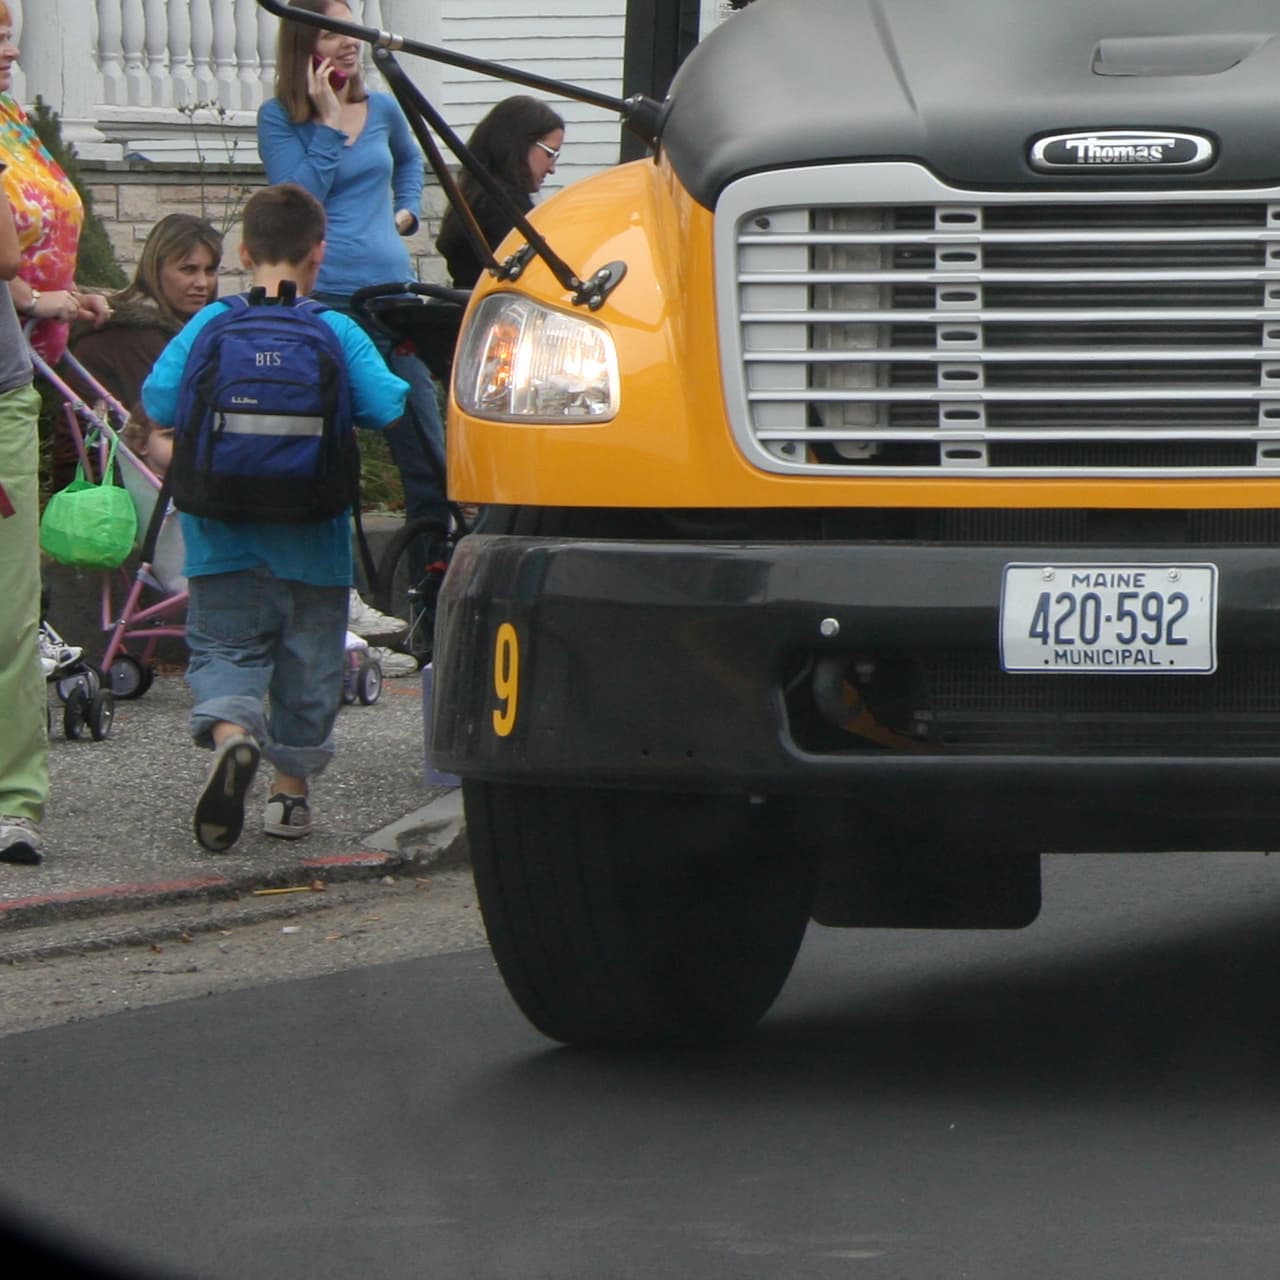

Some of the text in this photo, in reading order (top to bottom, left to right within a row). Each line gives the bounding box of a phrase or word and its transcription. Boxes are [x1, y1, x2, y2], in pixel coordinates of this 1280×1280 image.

[1066, 138, 1175, 164] Thomas
[256, 352, 281, 366] BTS
[1072, 573, 1147, 589] MAINE
[1054, 649, 1161, 666] MUNICIPAL
[492, 622, 519, 737] 9
